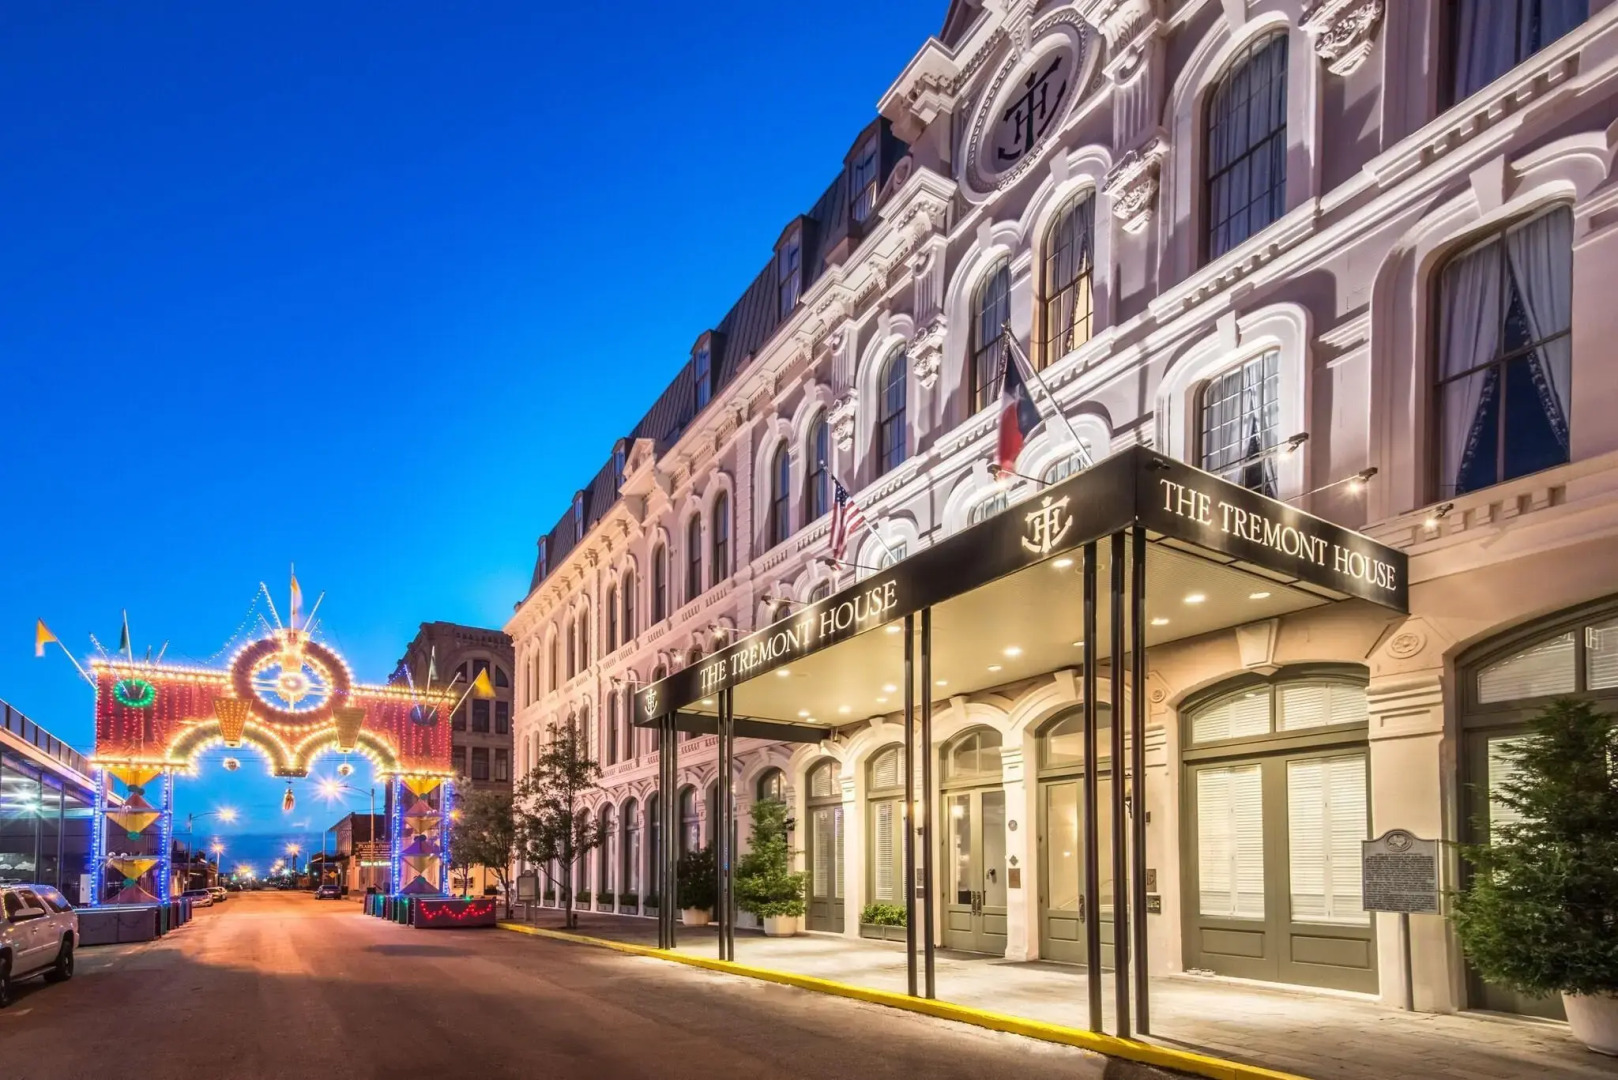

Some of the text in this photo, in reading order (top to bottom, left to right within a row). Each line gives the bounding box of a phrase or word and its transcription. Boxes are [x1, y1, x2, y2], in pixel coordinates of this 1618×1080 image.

[1160, 478, 1396, 591] THE TREMONT HOUSE
[700, 579, 898, 689] THE TREMONT HOUSE
